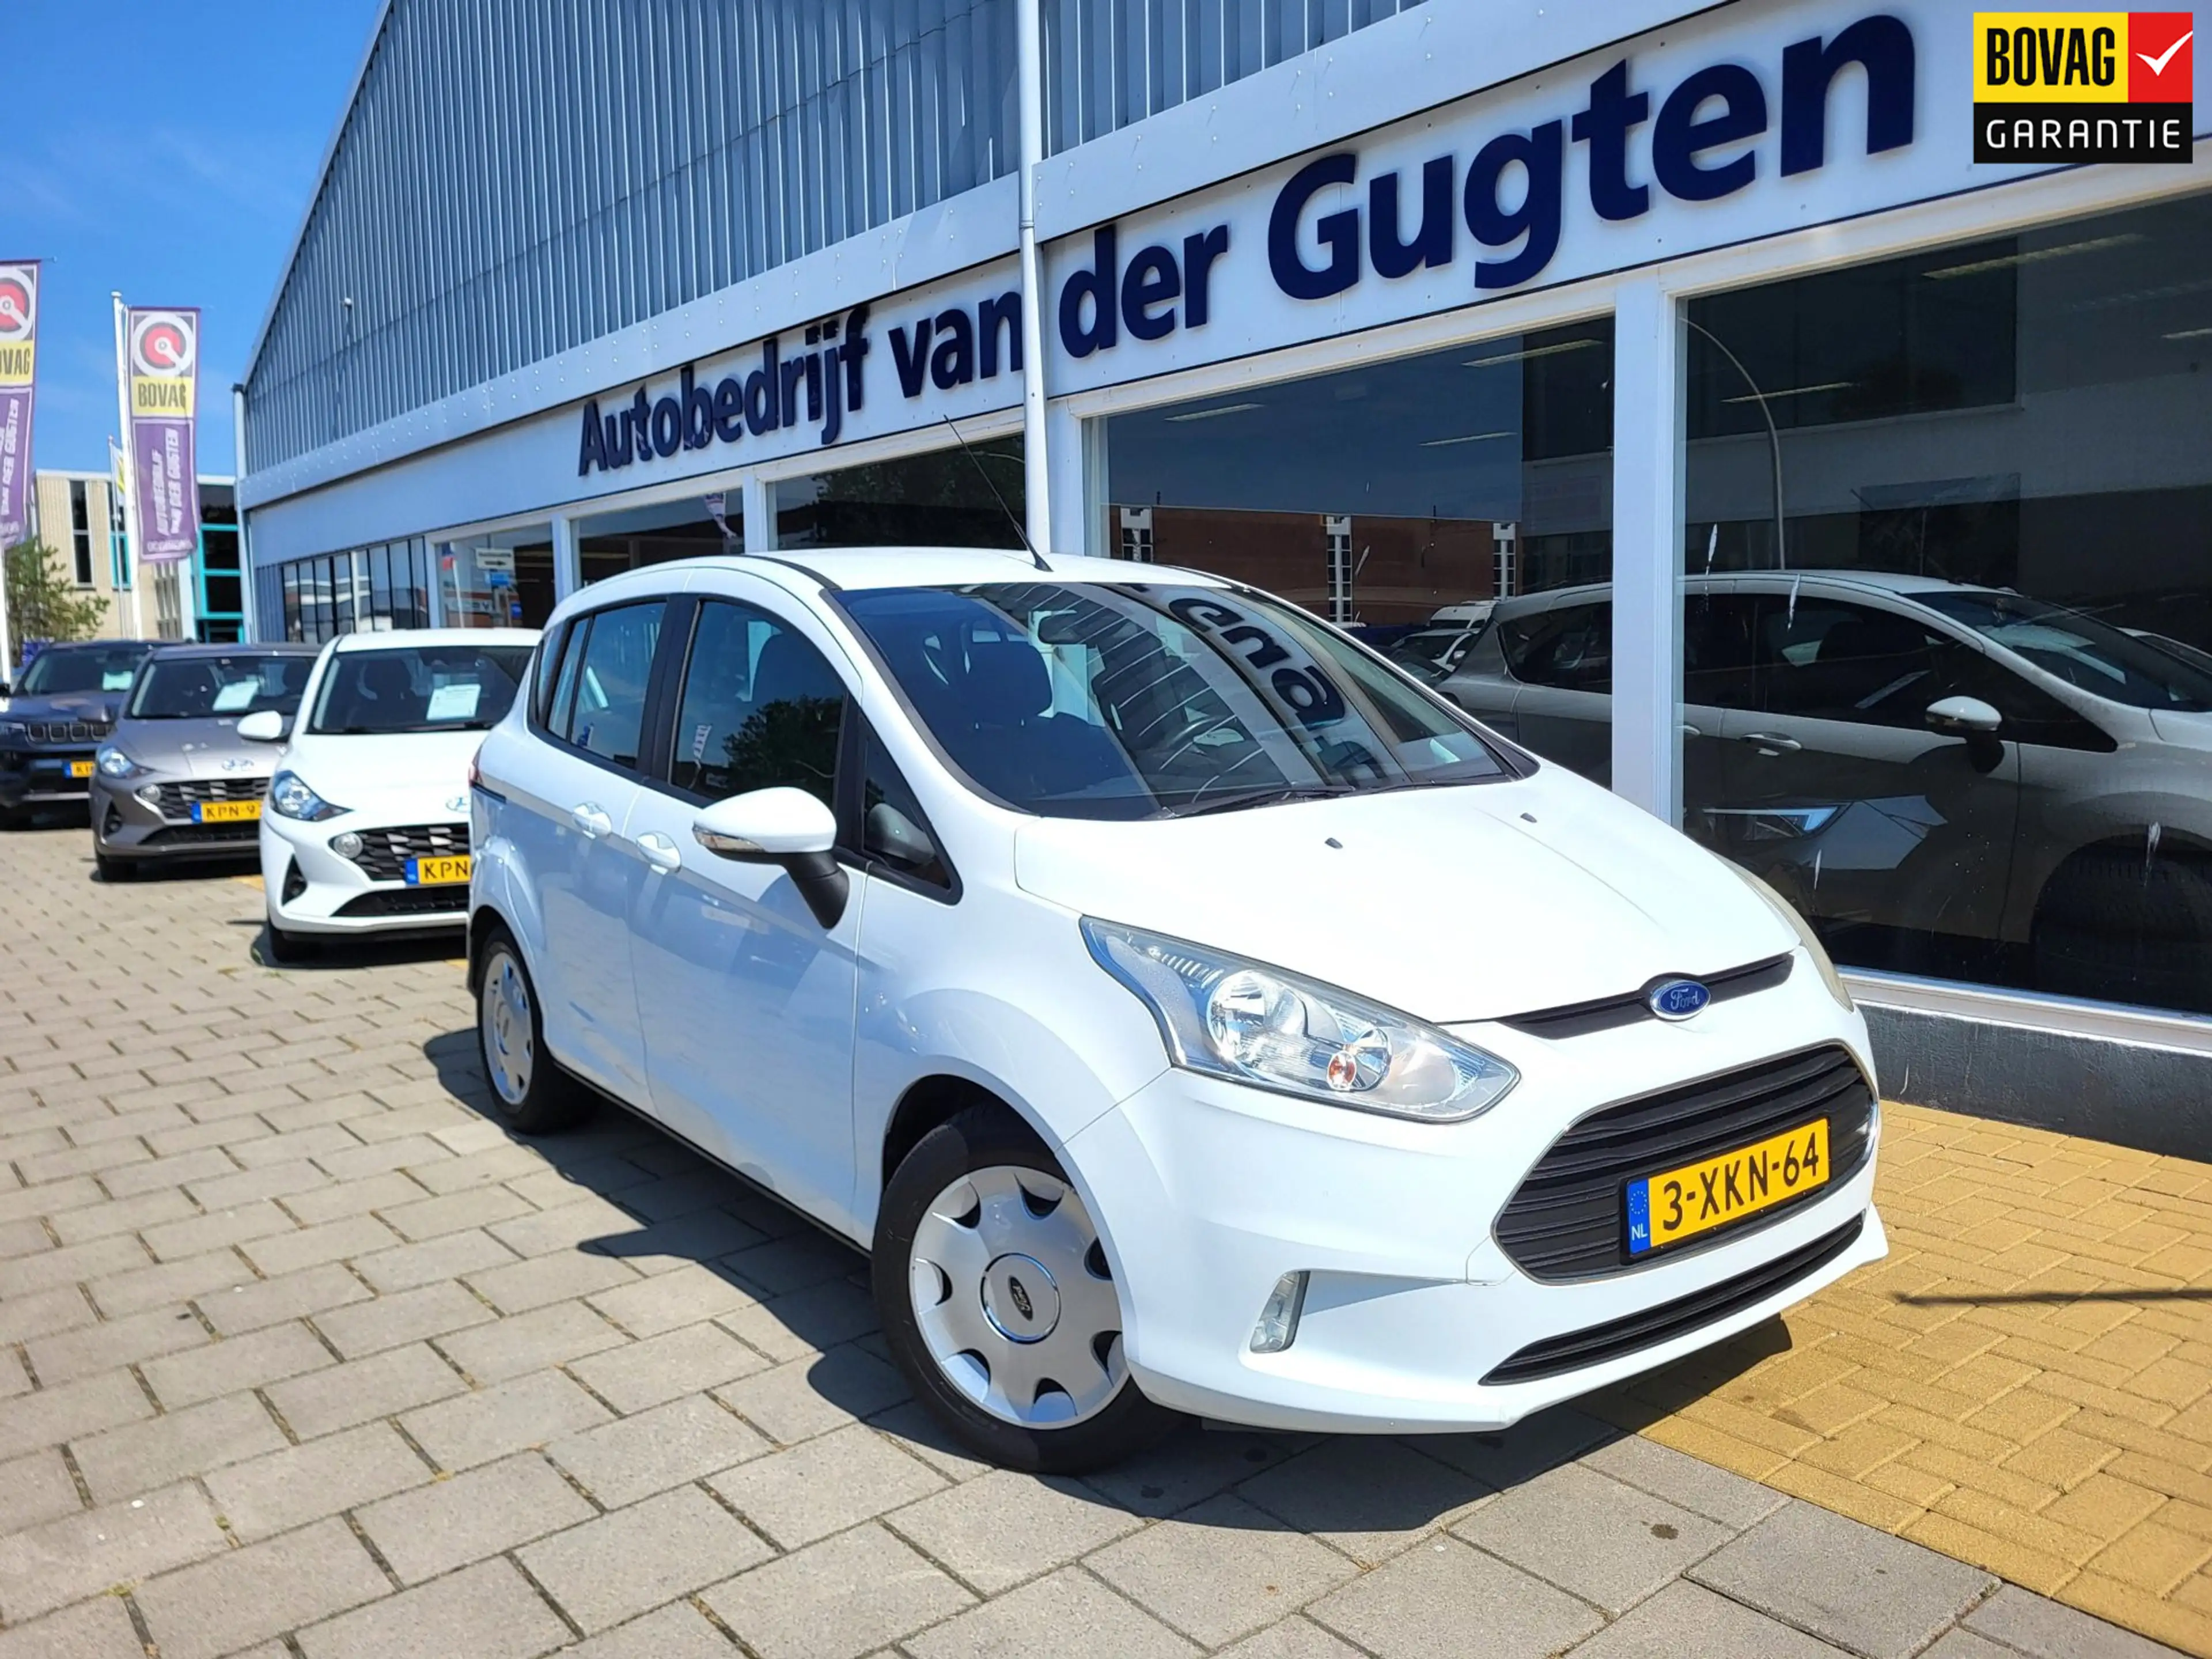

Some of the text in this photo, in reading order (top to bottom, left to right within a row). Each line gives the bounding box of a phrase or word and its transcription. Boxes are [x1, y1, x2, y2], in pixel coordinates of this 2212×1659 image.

[578, 13, 1916, 477] Autobedrijf van der Gugten
[138, 382, 187, 408] BOVAG
[423, 861, 468, 879] KPN
[1670, 987, 1700, 1010] Ford
[1662, 1131, 1820, 1232] 3-XKN-64
[1631, 1224, 1647, 1241] NL
